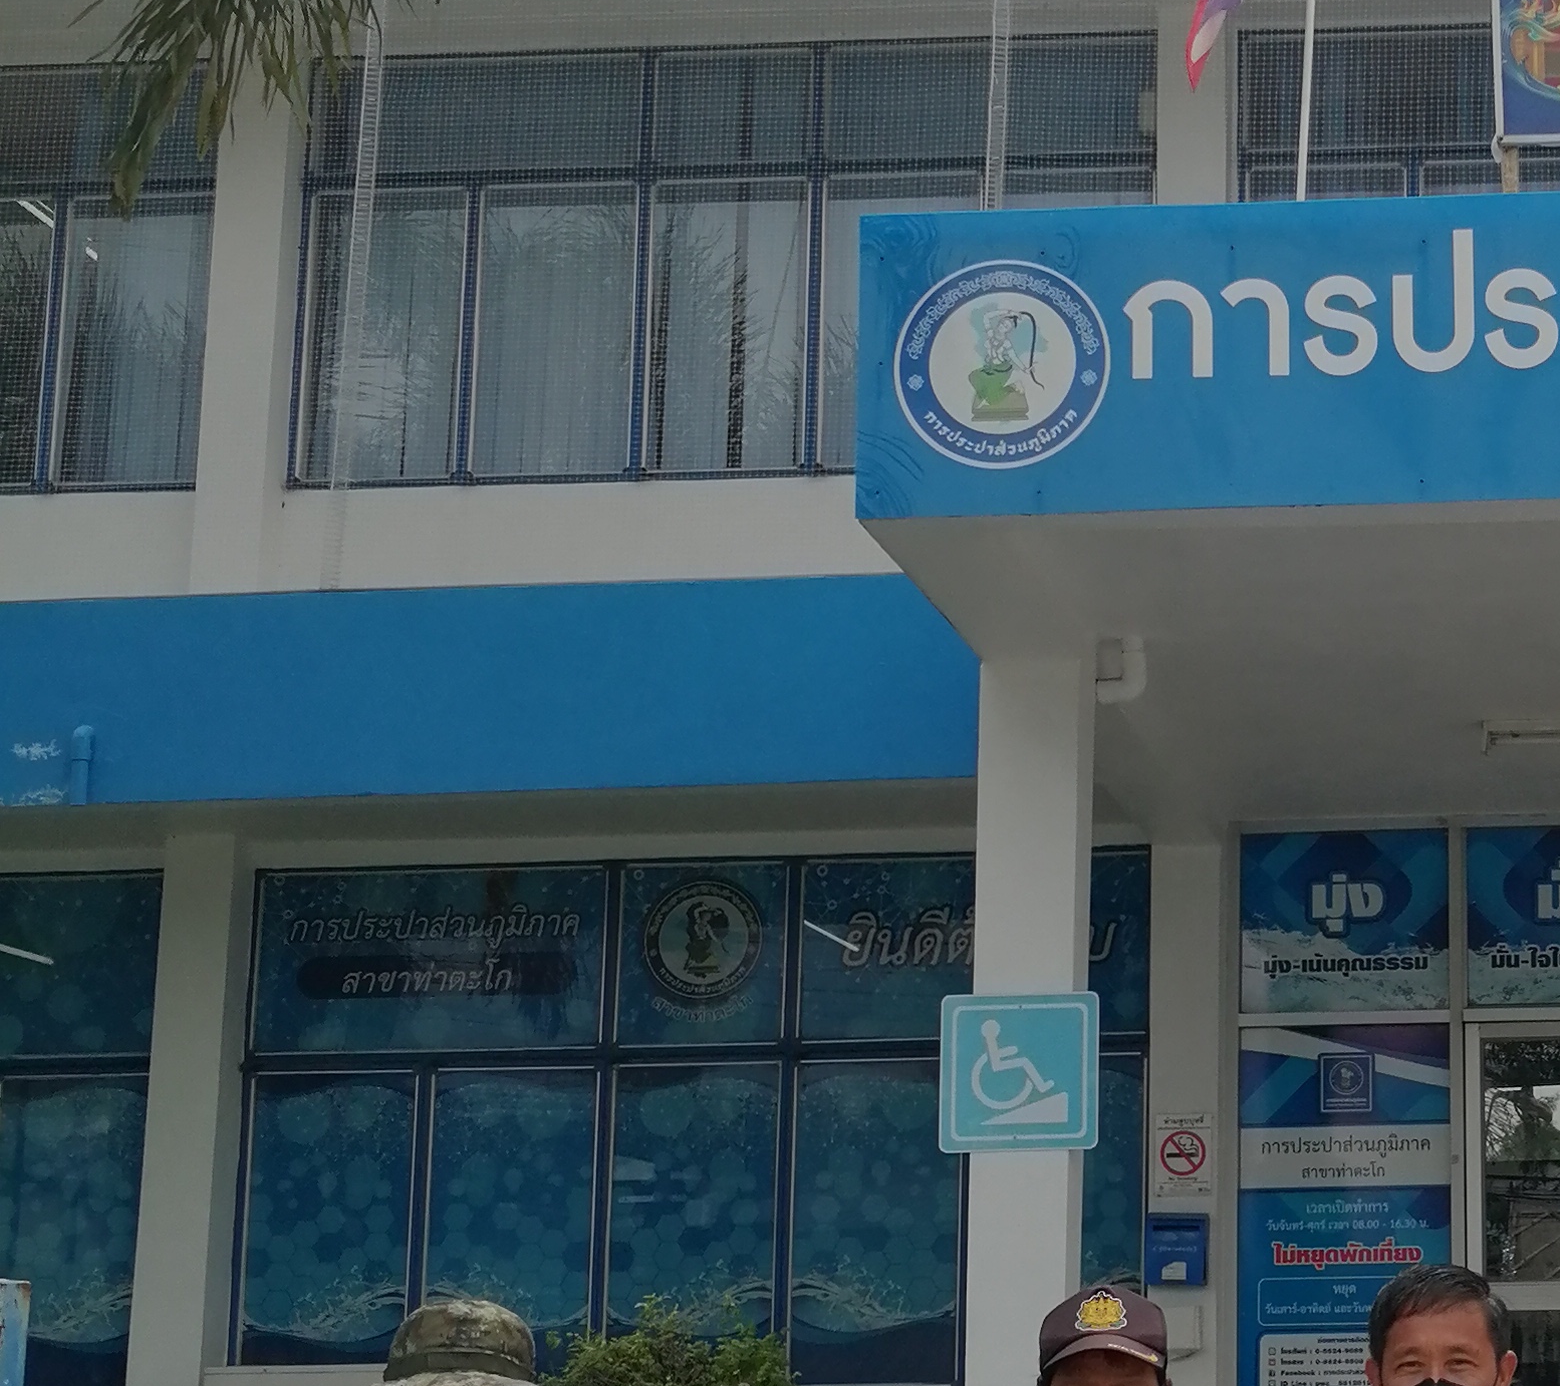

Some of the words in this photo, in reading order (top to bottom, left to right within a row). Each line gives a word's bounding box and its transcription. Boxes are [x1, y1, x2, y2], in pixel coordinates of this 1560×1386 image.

[924, 409, 1078, 456] การประปาส่วนภูมิภาค
[1311, 873, 1384, 932] มุ่ง
[290, 903, 581, 949] การประปาส่วนภูมิภาค
[341, 957, 514, 994] สาขาท่าตะโก
[1263, 952, 1429, 980] มุ่ง-เน้นคุณธรรม
[1261, 1133, 1431, 1158] การประปาส่วนภูมิภาค
[1301, 1161, 1386, 1180] สาขาท่าตะโก
[1306, 1197, 1389, 1215] เวลาเปิดทำการ
[1271, 1236, 1423, 1270] ไม่หยุดพักเที่ยง
